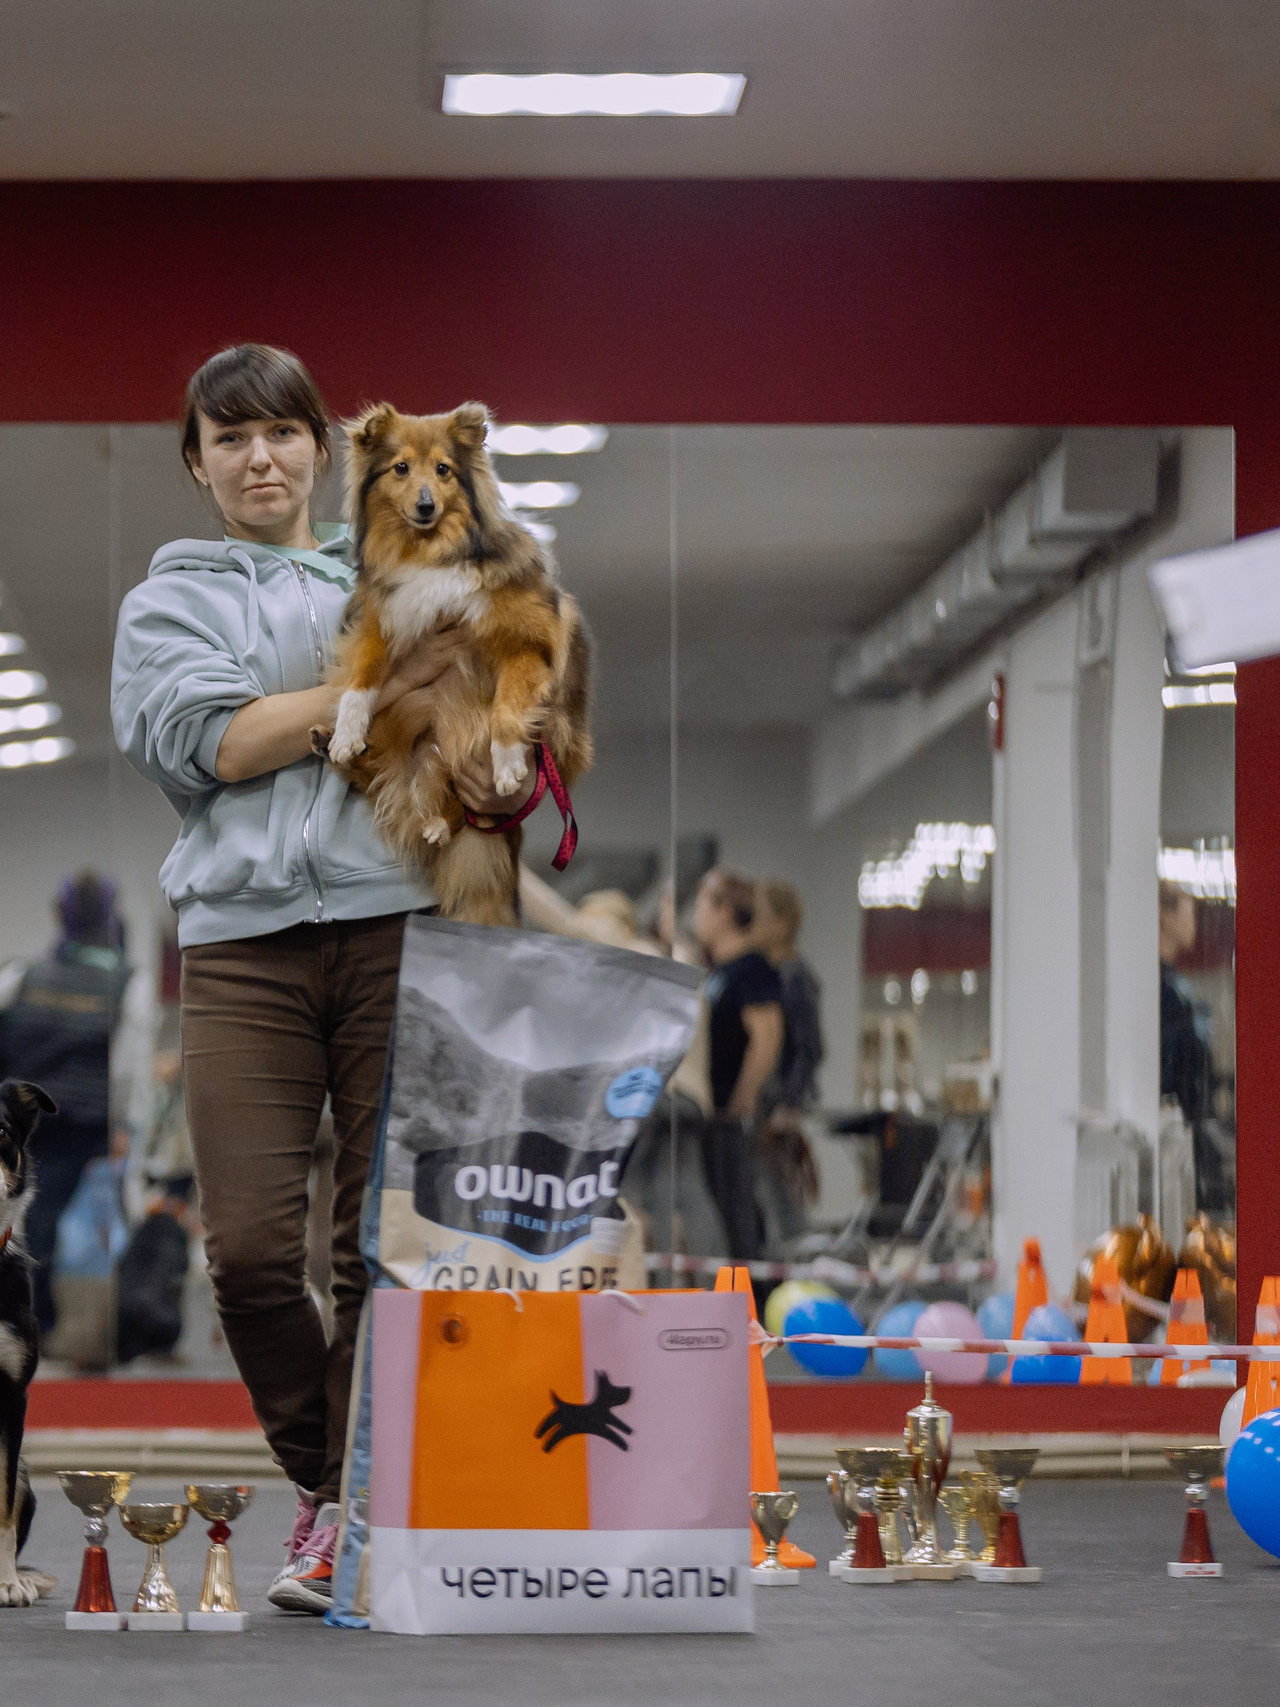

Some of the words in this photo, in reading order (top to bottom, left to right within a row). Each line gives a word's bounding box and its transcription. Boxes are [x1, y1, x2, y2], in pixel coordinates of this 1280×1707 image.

[454, 1160, 619, 1210] ownat
[433, 1264, 538, 1291] GRAIN
[440, 1566, 609, 1599] четыре
[621, 1566, 738, 1599] лапы
